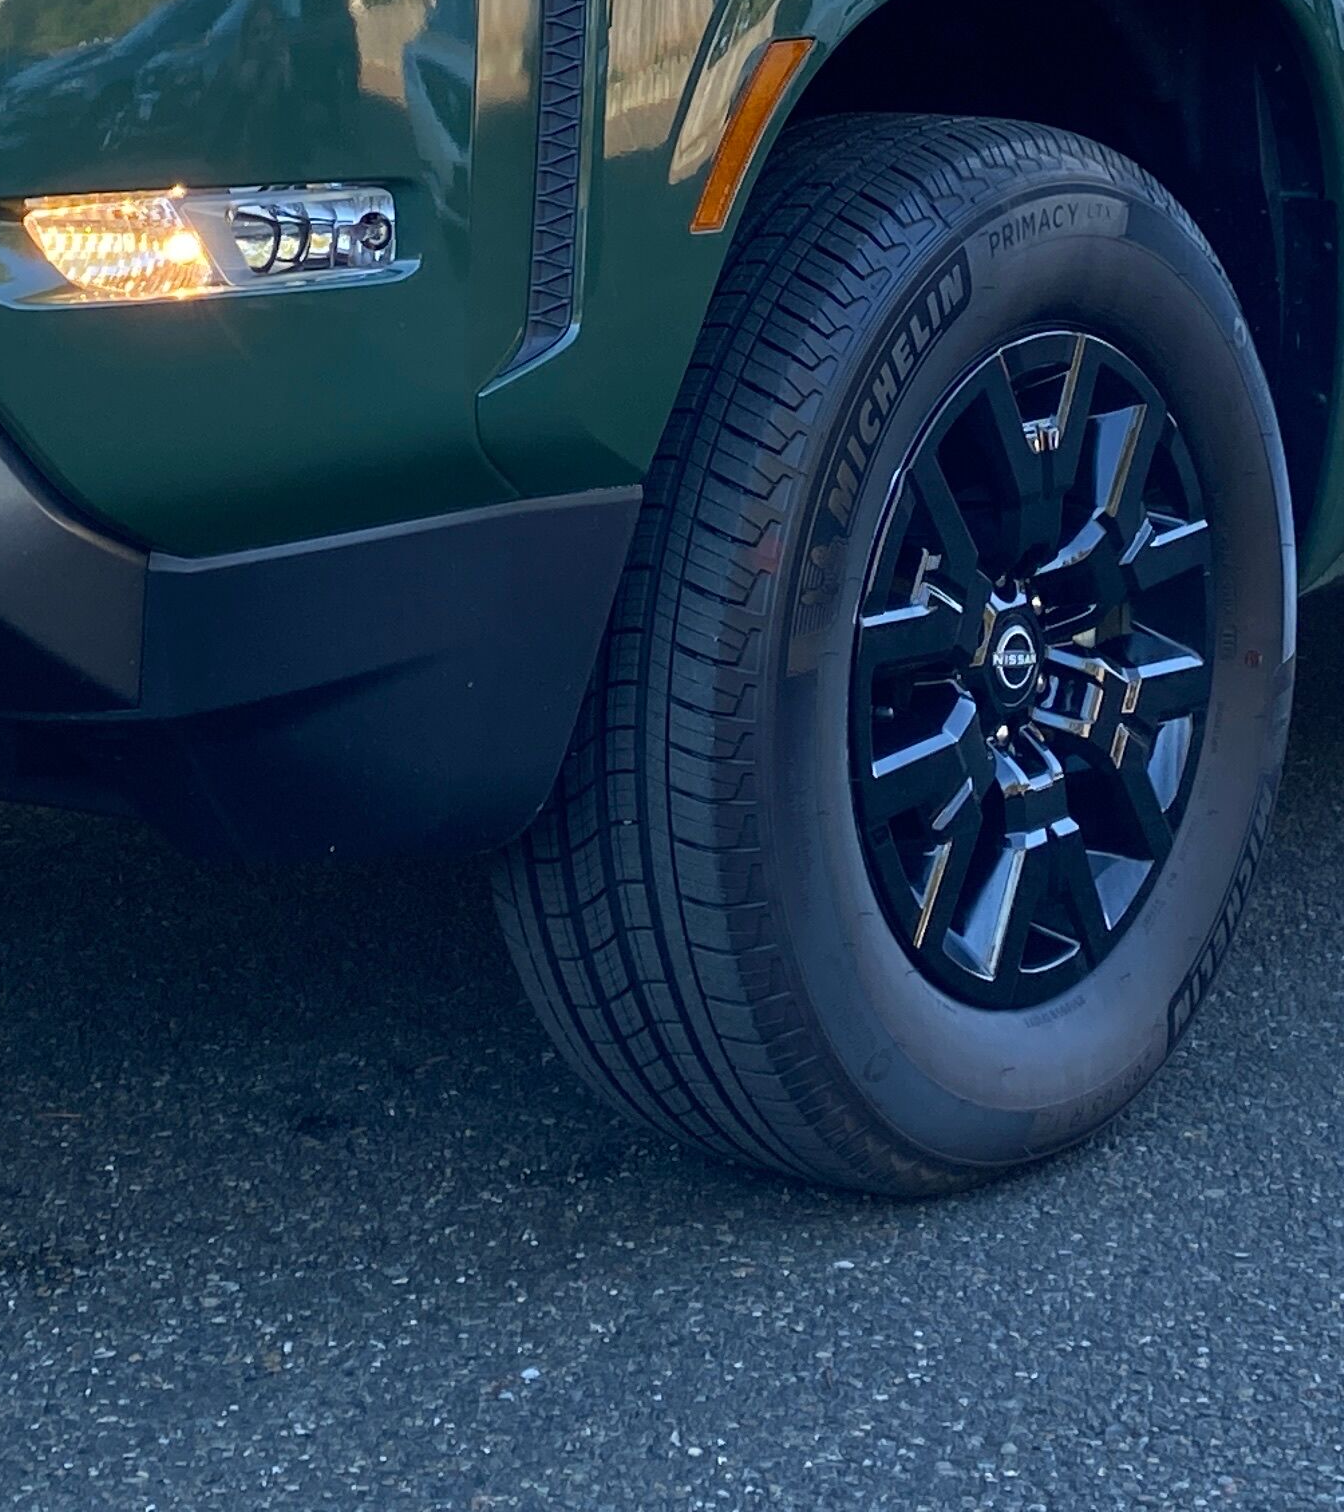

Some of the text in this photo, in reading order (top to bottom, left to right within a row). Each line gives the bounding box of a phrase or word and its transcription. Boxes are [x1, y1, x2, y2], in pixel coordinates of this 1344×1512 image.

[986, 201, 1081, 260] PRIMACY
[827, 263, 966, 531] MICHELIN
[992, 651, 1037, 666] NISSAN
